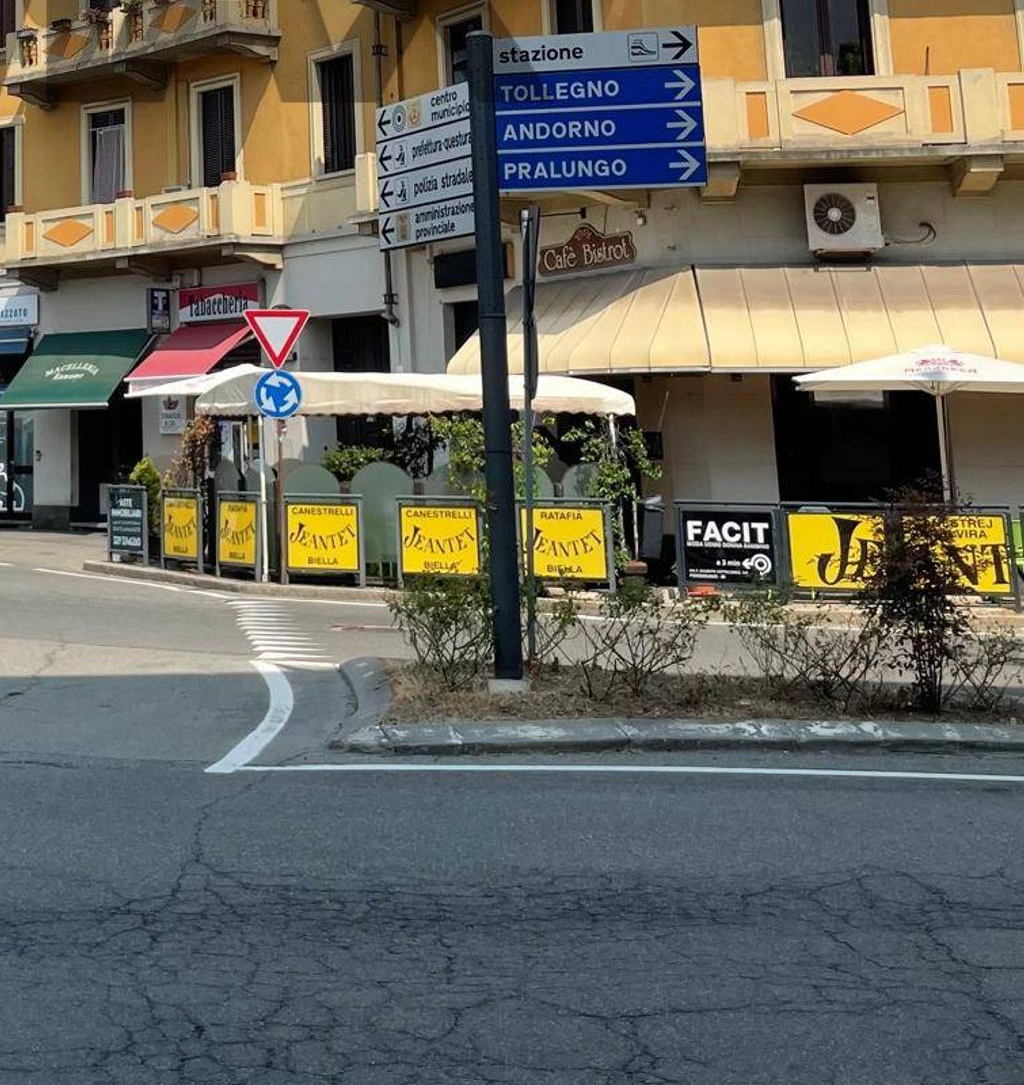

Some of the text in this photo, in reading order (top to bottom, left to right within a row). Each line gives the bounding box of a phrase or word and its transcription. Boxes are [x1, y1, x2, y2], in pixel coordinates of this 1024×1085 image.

[498, 45, 584, 63] stazione
[430, 90, 458, 107] centro
[500, 79, 620, 102] TOLLEGNO
[431, 101, 471, 122] municipio
[503, 119, 616, 141] ANDORNO
[504, 158, 627, 180] PRALUNGO
[413, 167, 474, 198] polizia stradale
[415, 221, 456, 241] provinciale
[582, 238, 630, 265] Bistrot
[189, 292, 249, 317] Tabaccheria
[291, 507, 355, 516] CANESTRELLI
[405, 509, 474, 519] CANESTRELLI
[289, 522, 355, 551] JEANTET
[404, 525, 475, 554] JEANTET
[686, 520, 770, 543] FACIT
[307, 556, 339, 565] BIELLA
[727, 559, 741, 567] min
